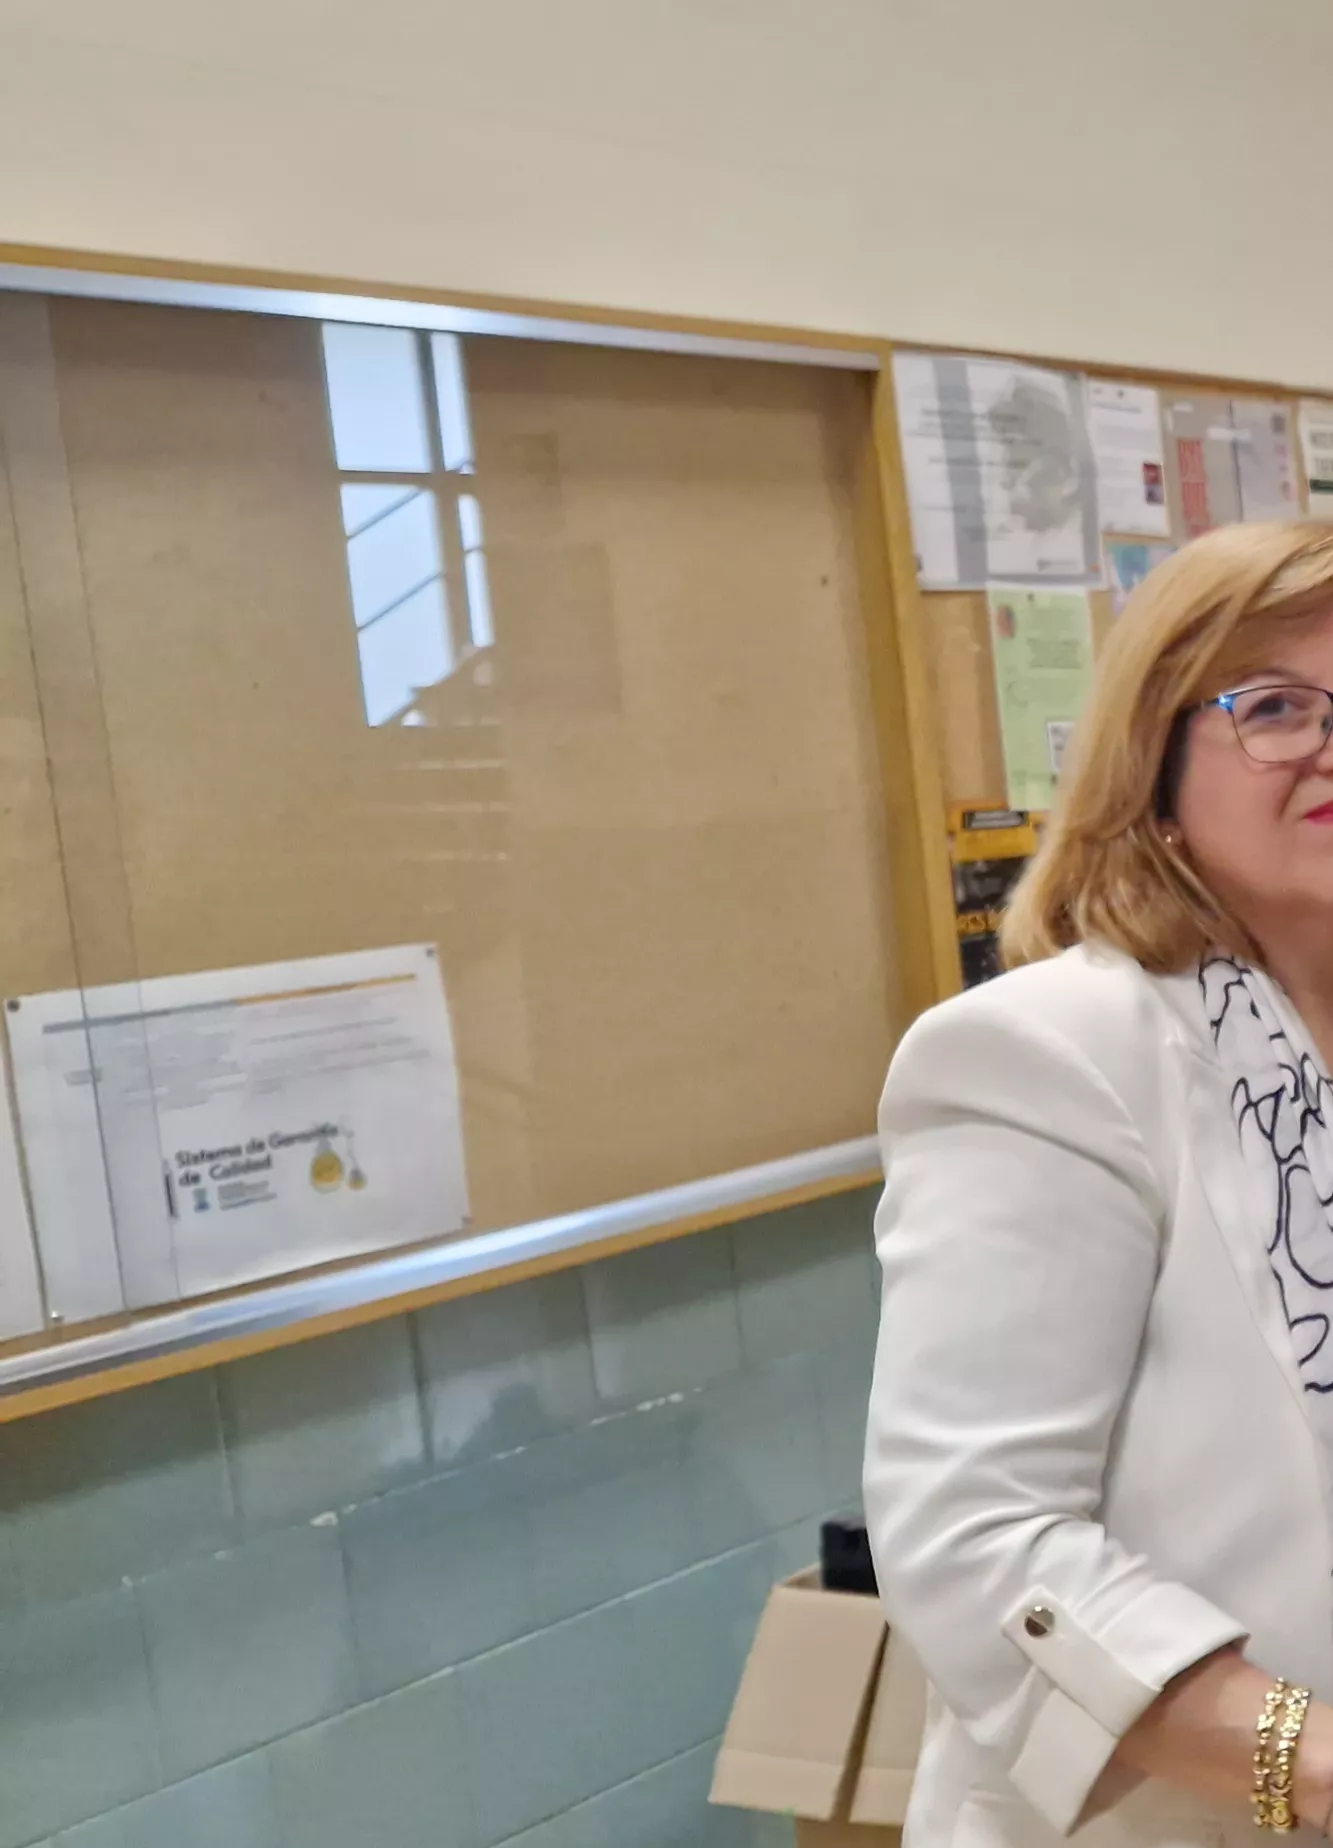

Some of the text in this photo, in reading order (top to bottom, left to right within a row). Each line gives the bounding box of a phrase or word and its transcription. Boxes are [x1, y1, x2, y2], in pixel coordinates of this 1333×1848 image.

[175, 1145, 243, 1169] Sistema
[245, 1137, 266, 1155] de
[178, 1153, 272, 1187] de Calidad
